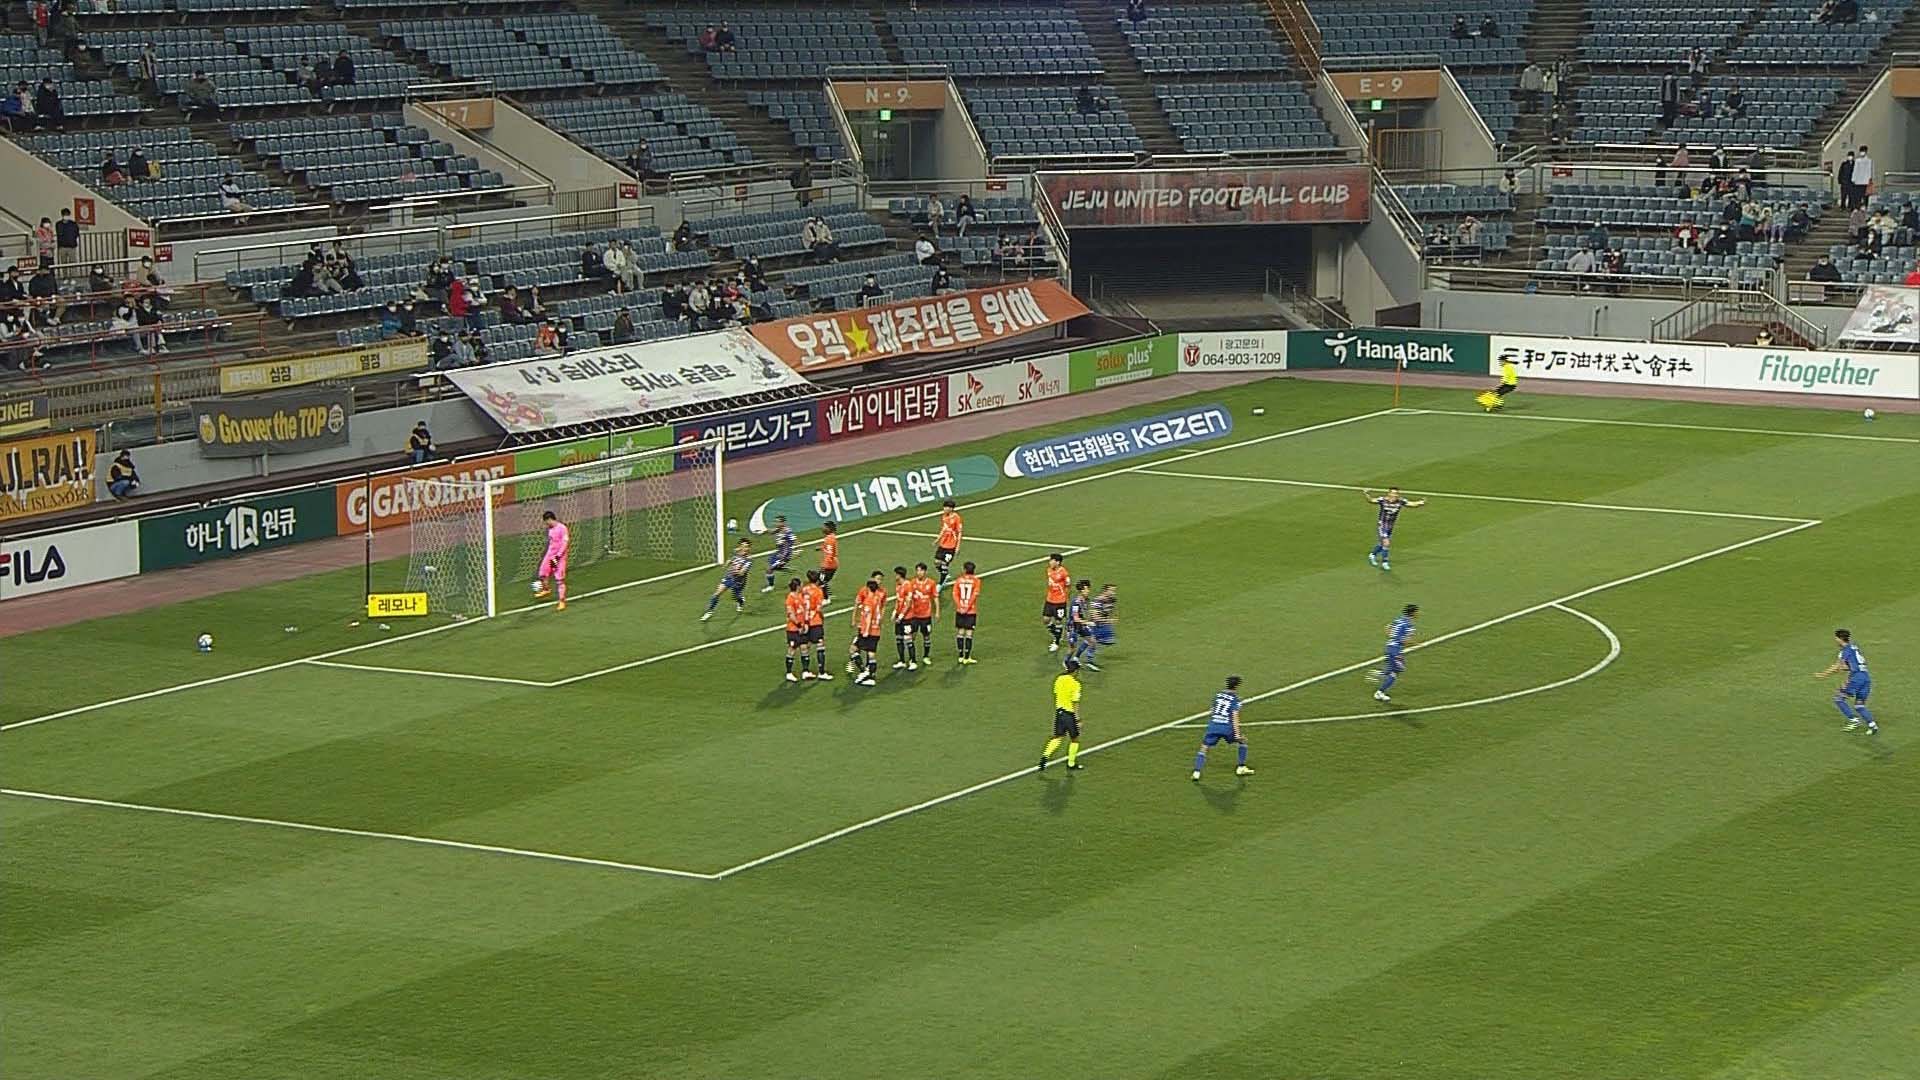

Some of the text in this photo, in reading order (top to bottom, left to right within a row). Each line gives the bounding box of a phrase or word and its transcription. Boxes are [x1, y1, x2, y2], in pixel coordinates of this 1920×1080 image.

[1062, 184, 1349, 210] JEJU UNITED FOOTBALL CLUB
[787, 286, 1049, 366] 오직 제주만을 위해
[1225, 338, 1260, 350] 광고문의
[1356, 339, 1455, 364] HanaBank
[557, 353, 643, 381] 숨비소리
[620, 363, 737, 393] 역사의 숨결로
[1758, 353, 1881, 389] Fitogether
[957, 392, 1005, 412] SK energy
[1019, 382, 1033, 400] SK
[848, 382, 941, 432] 신이내린닭
[219, 406, 328, 444] Go over the TOP
[1022, 431, 1131, 473] 현대고급휘발유
[812, 482, 868, 522] 하나
[906, 464, 954, 502] 원큐
[185, 519, 224, 553] 하나
[261, 506, 297, 540] 원큐
[377, 596, 417, 613] 레모나
